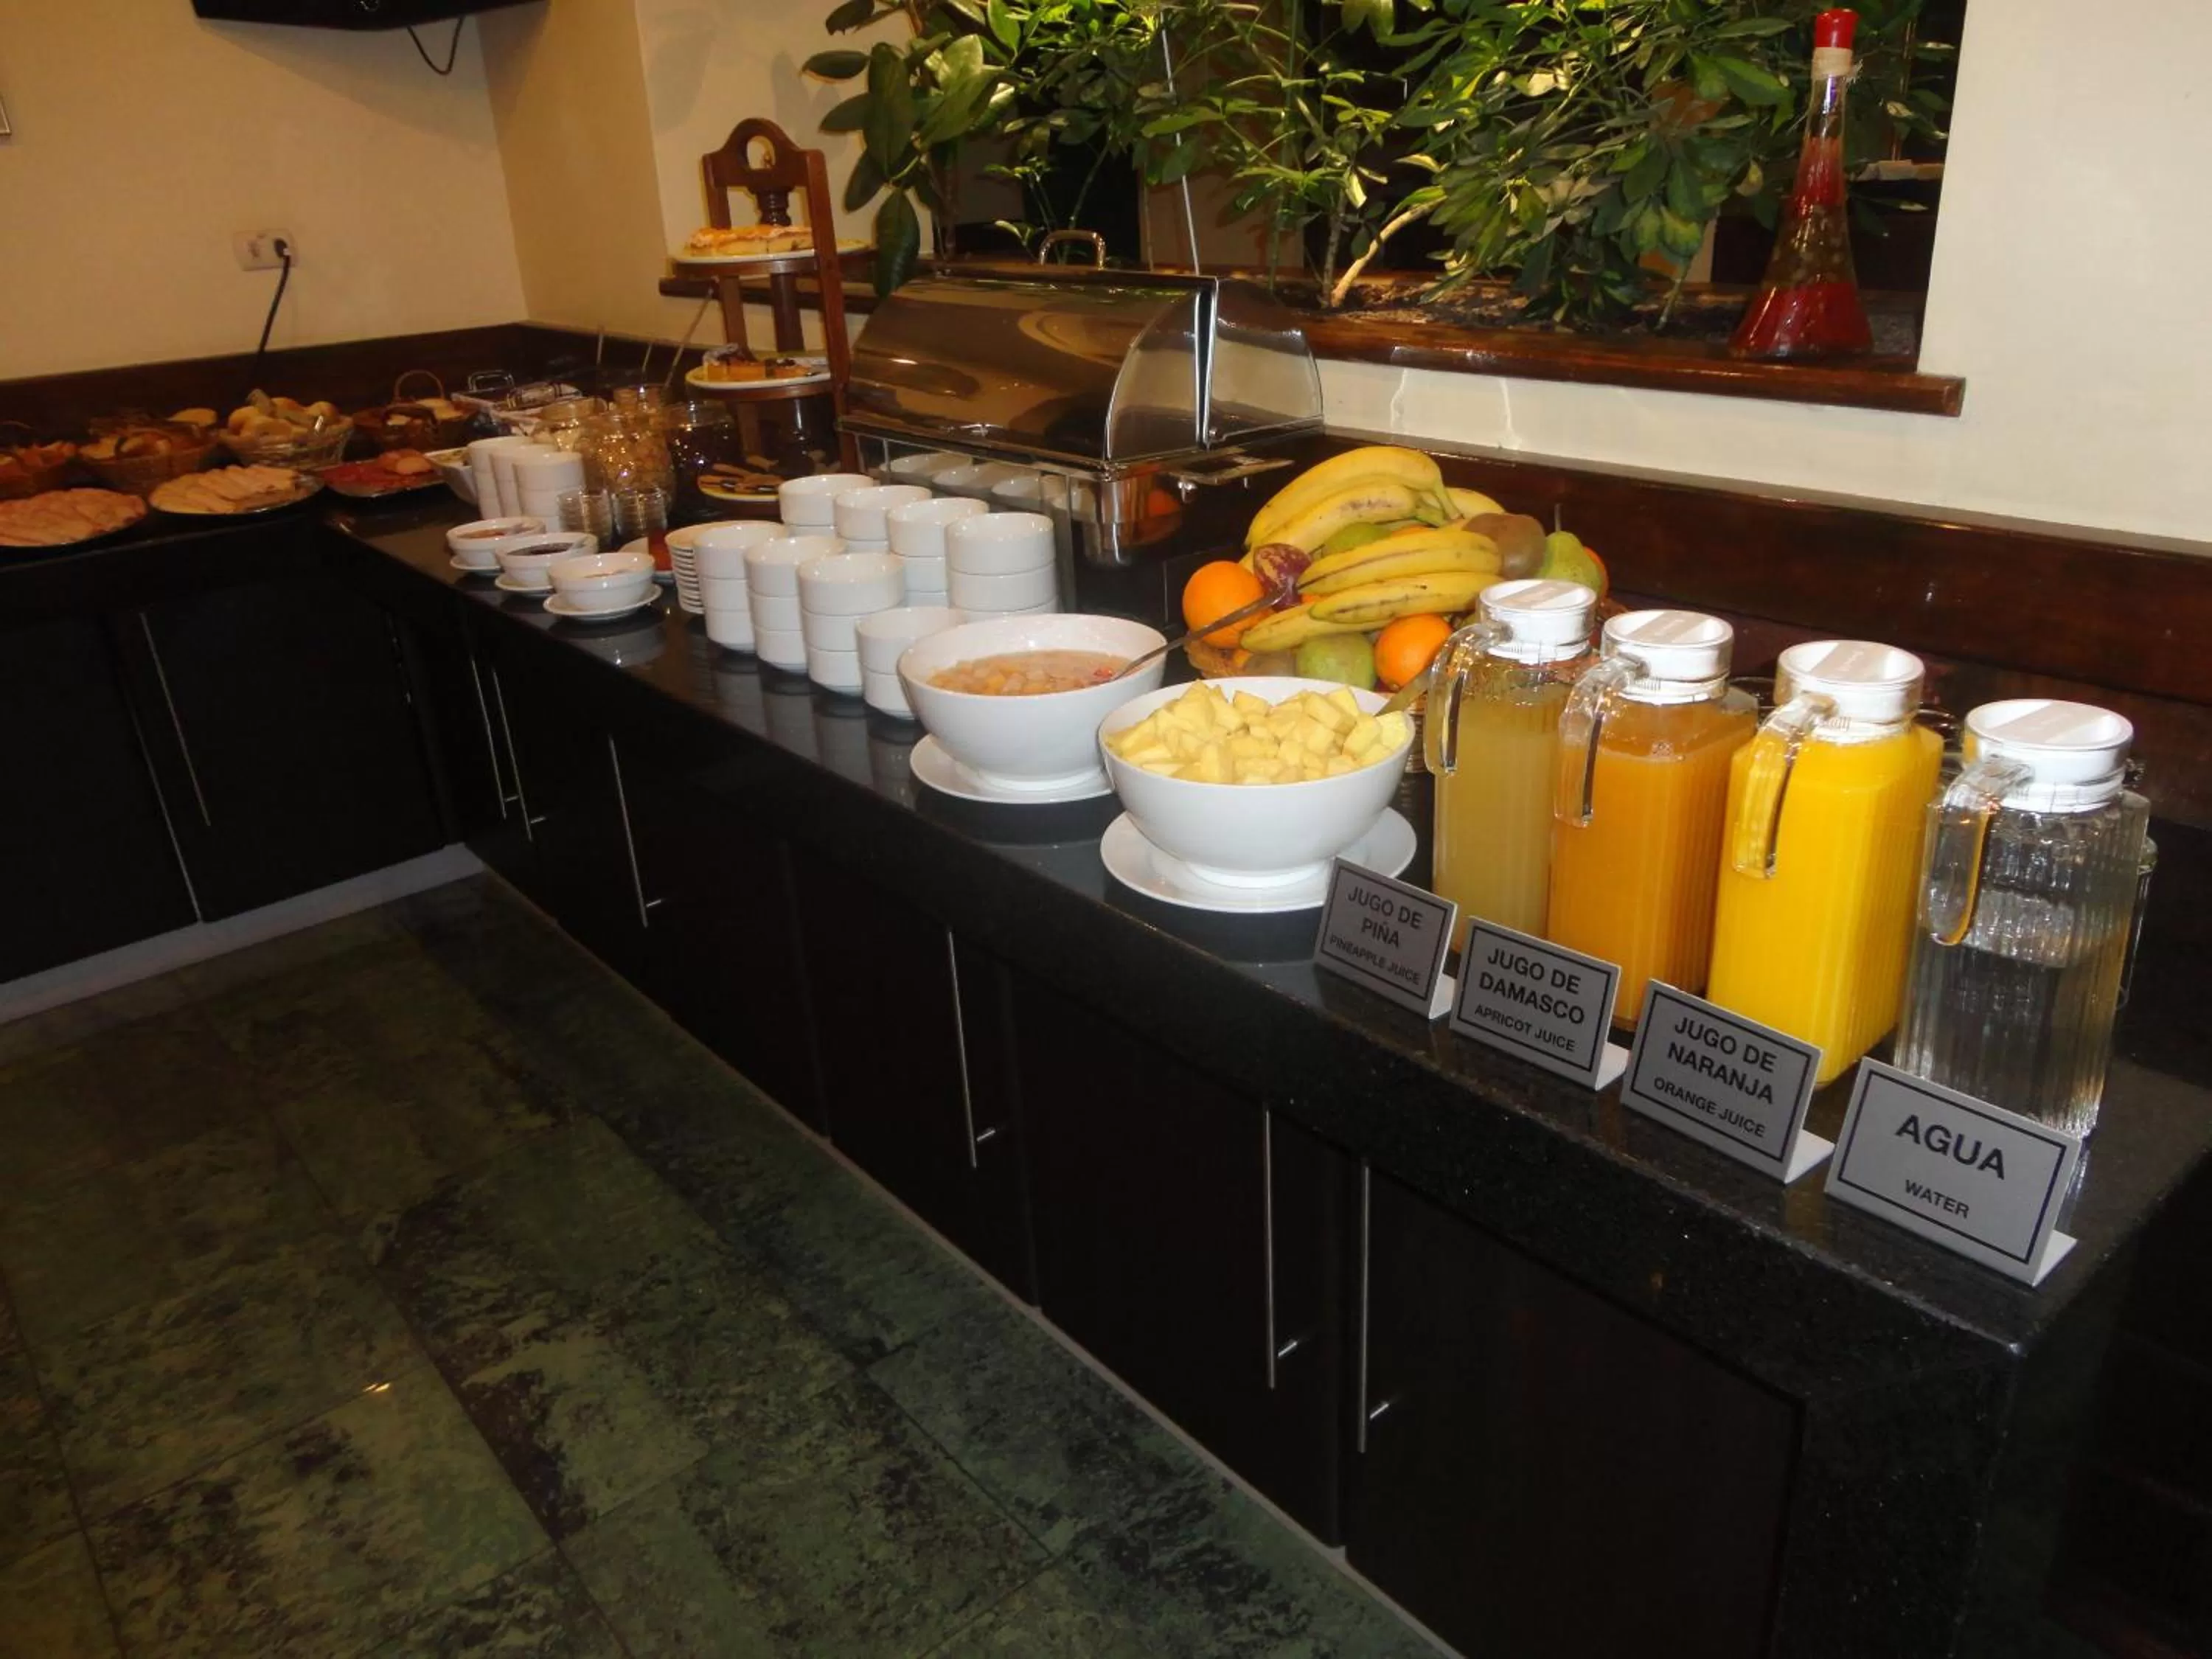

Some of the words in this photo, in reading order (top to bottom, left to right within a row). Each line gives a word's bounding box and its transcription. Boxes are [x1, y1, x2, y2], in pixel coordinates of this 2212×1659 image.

[1348, 886, 1394, 917] JUGO
[1398, 905, 1423, 930] DE
[1361, 917, 1399, 948] PIÑA
[1330, 933, 1385, 968] PINEAPPLE
[1388, 961, 1420, 986] JUICE
[1488, 948, 1545, 981] JUGO
[1551, 969, 1581, 995] DE
[1479, 971, 1585, 1024] DAMASCO
[1475, 1004, 1532, 1035] APRICOT
[1534, 1029, 1575, 1051] JUICE
[1674, 1018, 1736, 1055] JUGO
[1743, 1044, 1777, 1074] DE
[1668, 1042, 1773, 1105] NARANJA
[1654, 1077, 1717, 1115] ORANGE
[1718, 1108, 1766, 1138] JUICE
[1894, 1114, 2005, 1180] AGUA
[1905, 1179, 1969, 1220] WATER
